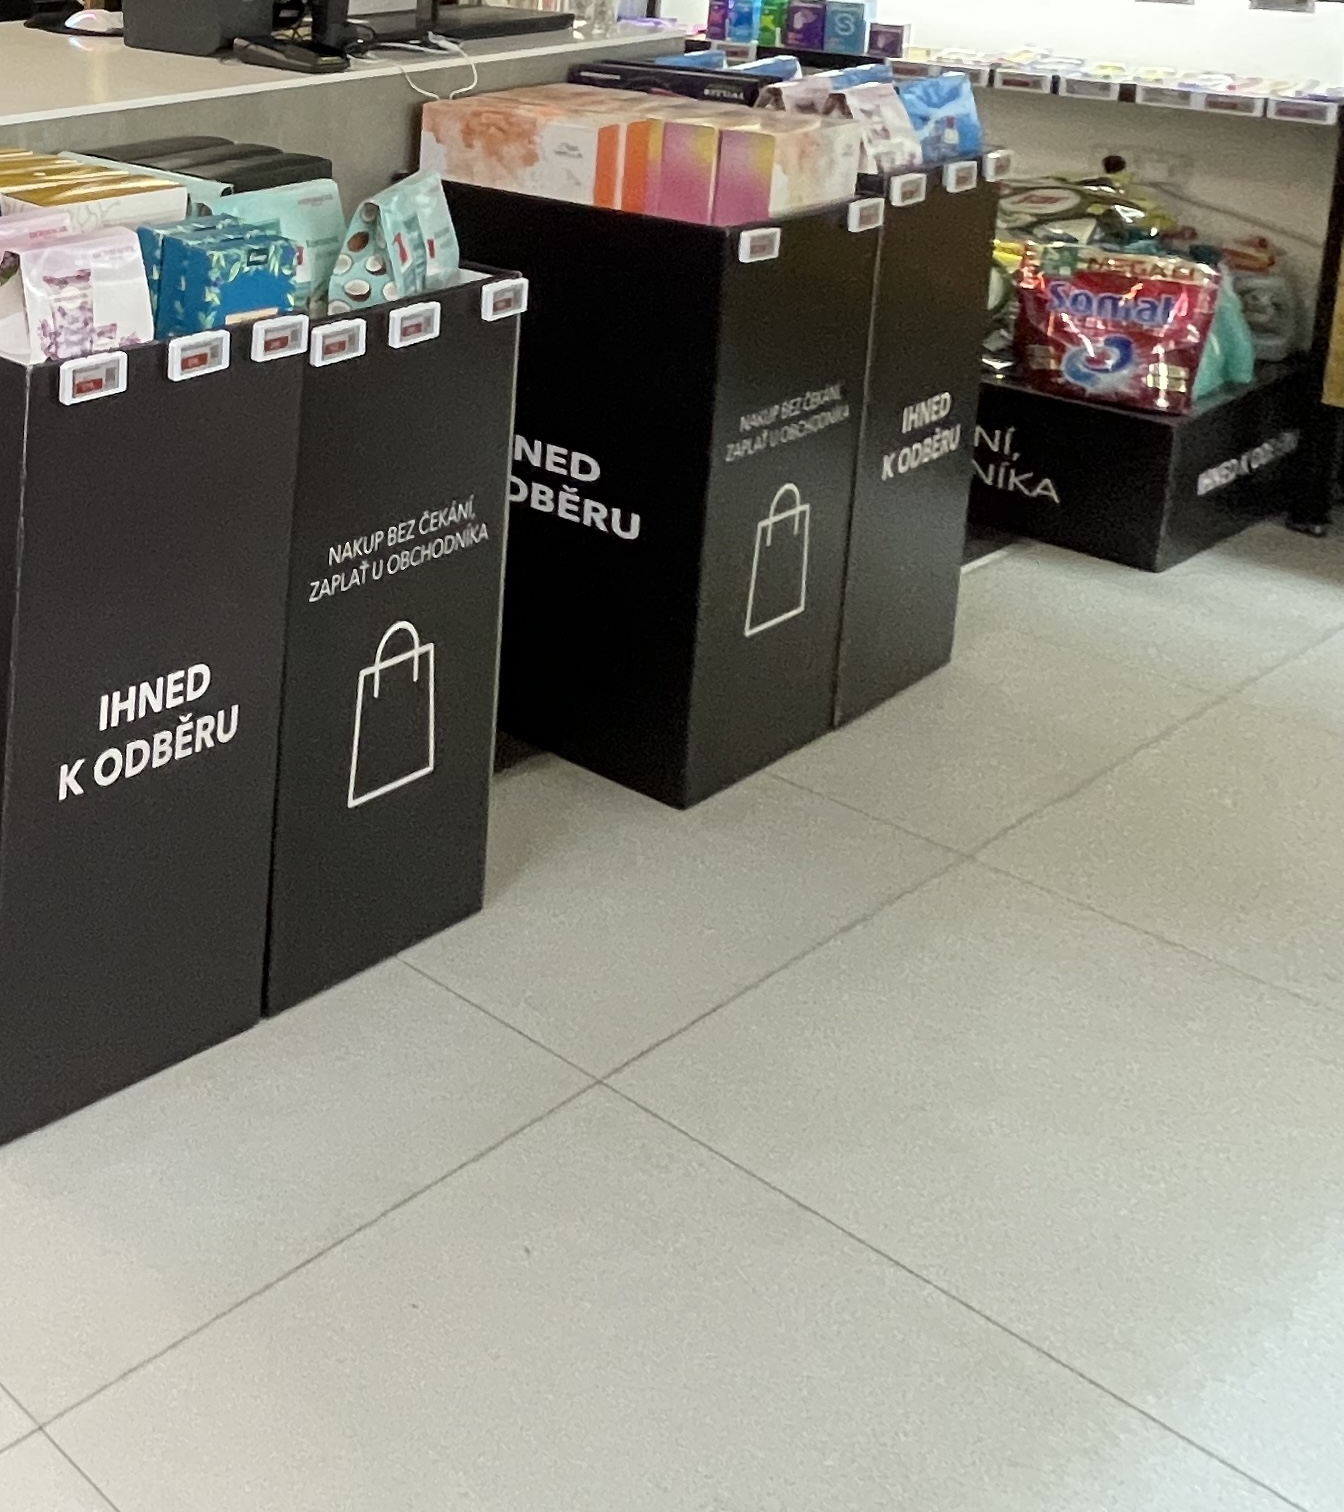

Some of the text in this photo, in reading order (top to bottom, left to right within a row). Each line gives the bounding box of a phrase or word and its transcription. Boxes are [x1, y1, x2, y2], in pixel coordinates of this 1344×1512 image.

[1045, 281, 1176, 327] Somat
[901, 391, 951, 434] IHNED
[514, 434, 601, 482] NED
[881, 453, 894, 481] K
[897, 423, 961, 474] ODBĚRU
[328, 497, 476, 566] NAKUP BEZ ČEKÁNÍ,
[508, 474, 641, 540] DBĚRU
[309, 522, 489, 603] ZAPLAŤ U OBCHODNÍKA
[99, 663, 211, 731] IHNED
[58, 704, 240, 802] K ODBĚRU
